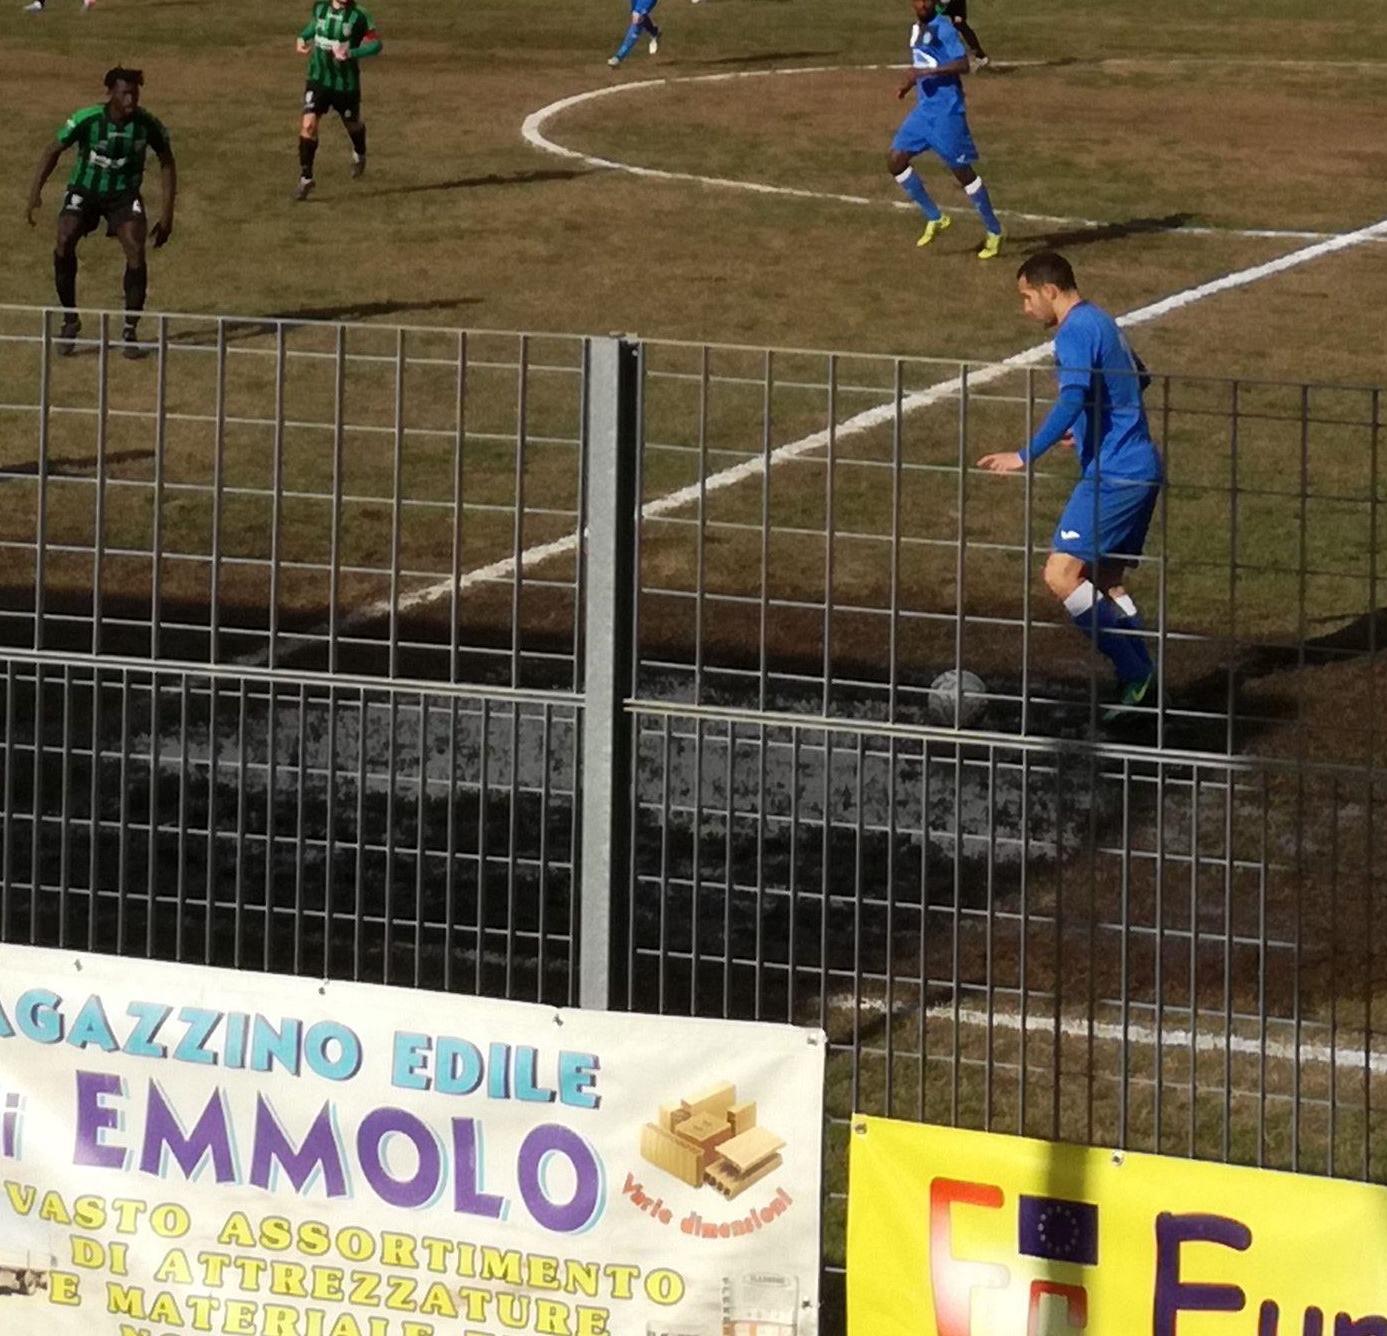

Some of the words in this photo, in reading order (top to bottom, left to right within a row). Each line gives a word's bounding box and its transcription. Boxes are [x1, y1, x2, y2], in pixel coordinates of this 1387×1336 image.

[391, 1030, 602, 1110] EDILE
[73, 1069, 607, 1236] EMMOLO
[4, 1180, 192, 1240] VASTO
[217, 1211, 686, 1306] ASSORTIMENTO
[49, 1269, 82, 1307] E
[70, 1234, 130, 1277] DI
[154, 1248, 610, 1336] ATTREZZATURE
